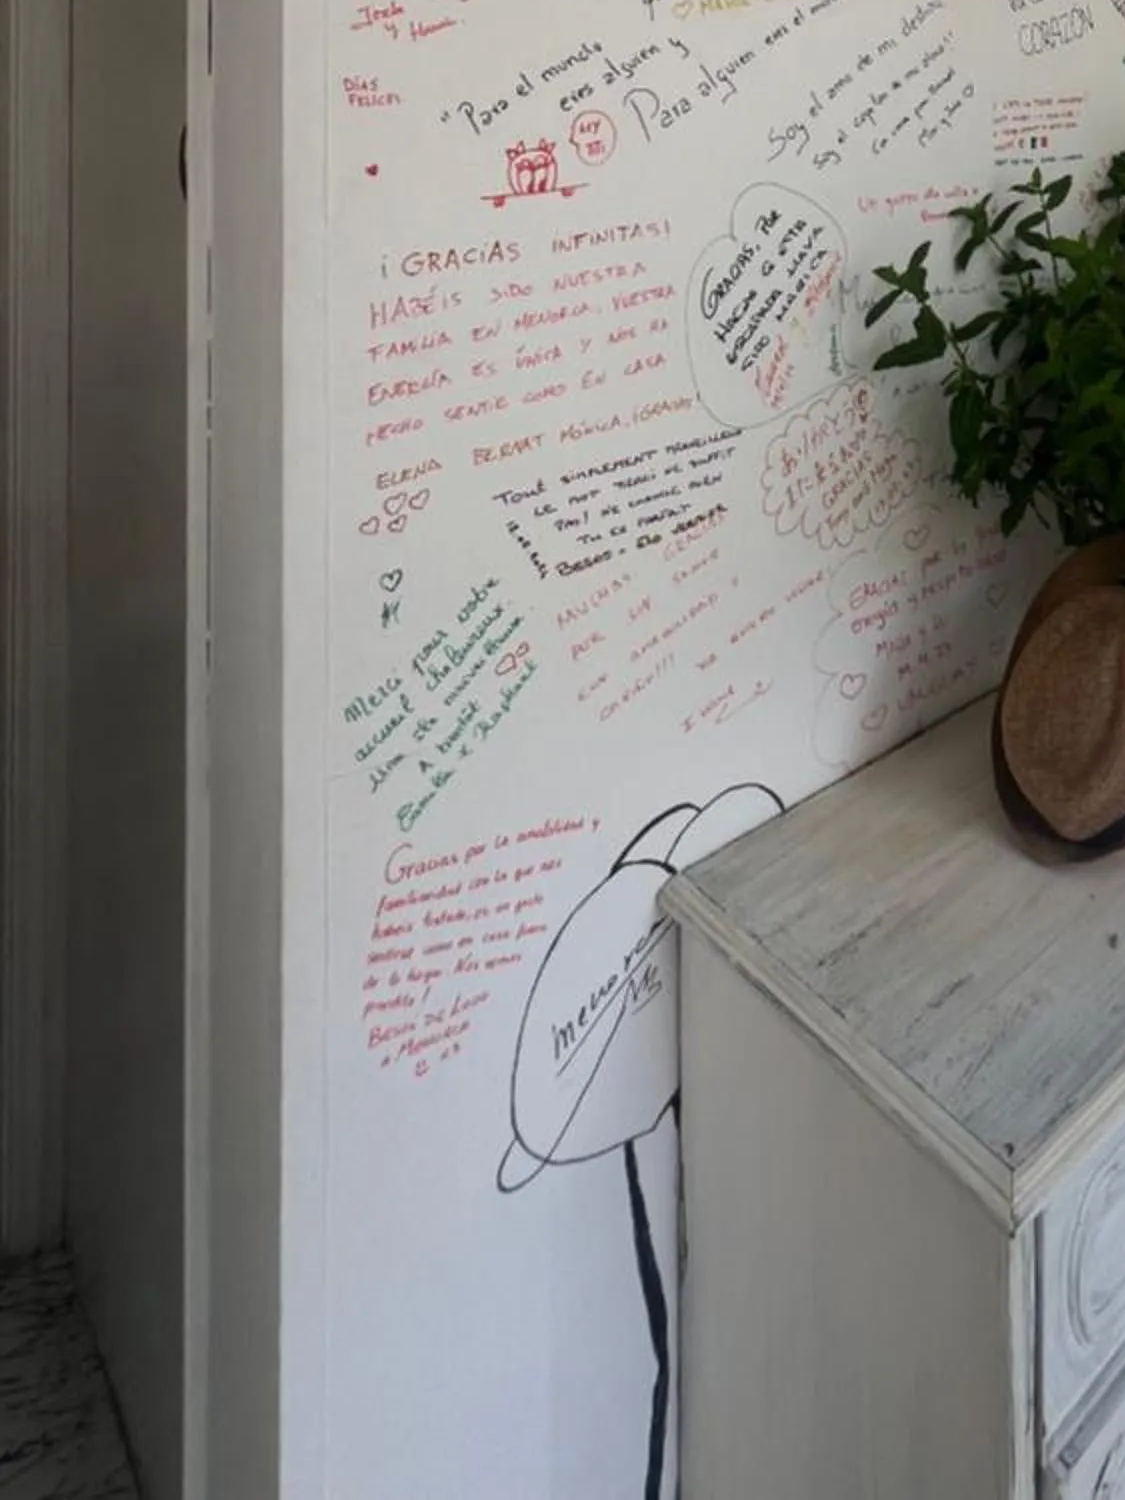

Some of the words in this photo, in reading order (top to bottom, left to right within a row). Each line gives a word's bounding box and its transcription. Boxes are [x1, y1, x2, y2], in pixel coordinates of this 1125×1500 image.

[516, 72, 535, 97] el
[541, 41, 603, 83] mundo
[602, 45, 661, 87] alguien
[623, 86, 692, 143] Para
[697, 50, 756, 103] alguien
[768, 123, 811, 163] Soy
[553, 262, 647, 294] NUESTRA
[472, 326, 502, 344] EN
[471, 361, 498, 378] ES
[375, 457, 443, 490] ELENA
[385, 842, 458, 886] Gracias
